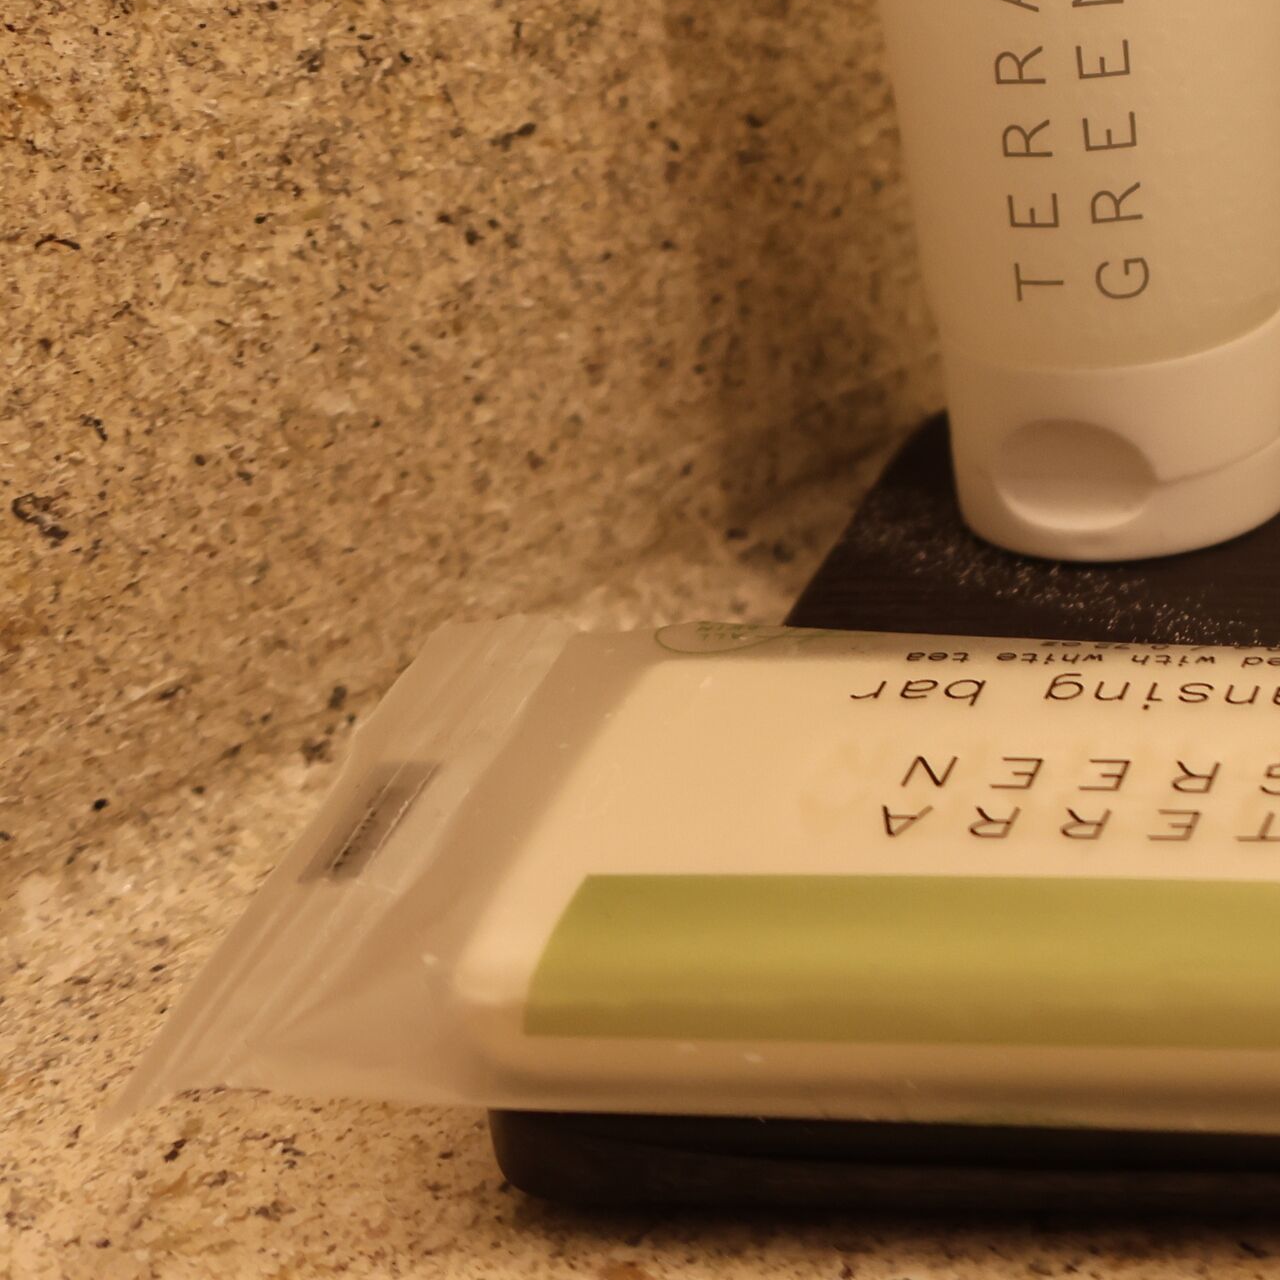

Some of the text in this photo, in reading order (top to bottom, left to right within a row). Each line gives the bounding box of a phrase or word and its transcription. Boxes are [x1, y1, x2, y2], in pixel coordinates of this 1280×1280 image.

[906, 651, 969, 664] tea
[996, 651, 1103, 666] white
[1131, 652, 1216, 668] with
[850, 679, 986, 706] bar
